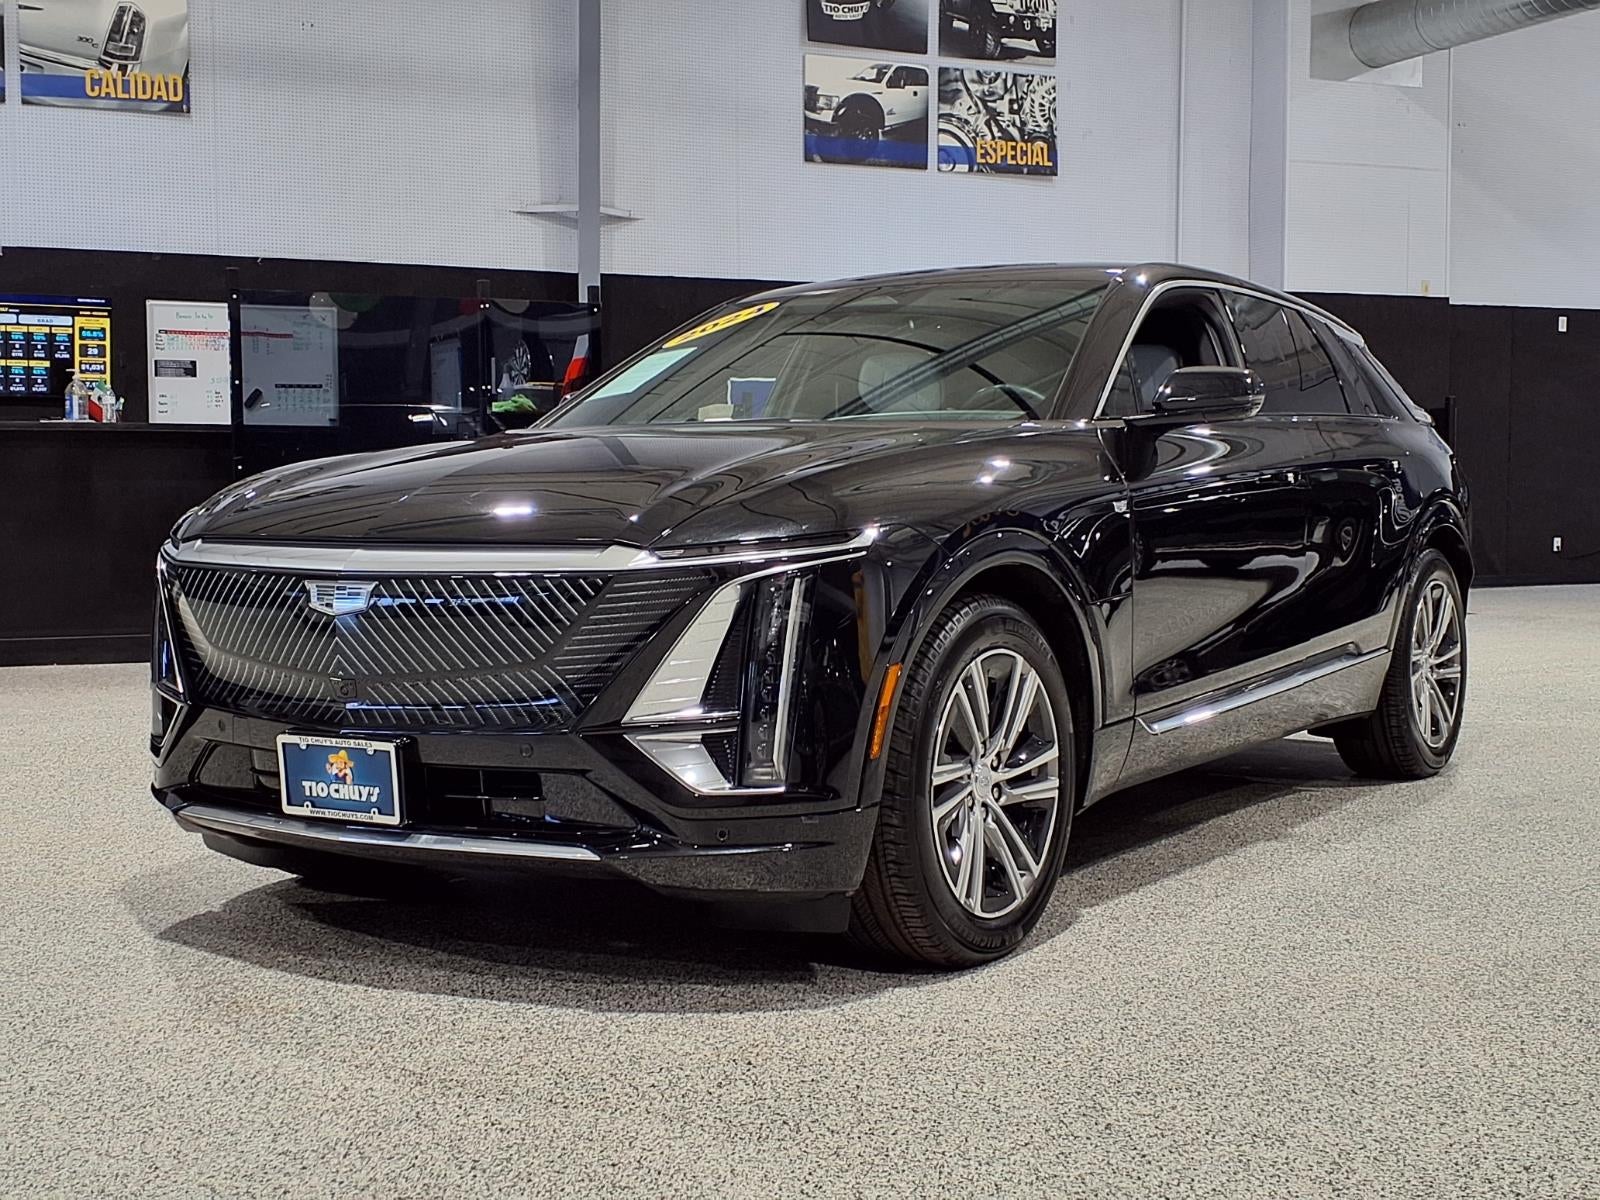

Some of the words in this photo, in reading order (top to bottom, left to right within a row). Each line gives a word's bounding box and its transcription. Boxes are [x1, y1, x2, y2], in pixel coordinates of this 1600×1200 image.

[823, 4, 840, 13] TIO
[84, 68, 184, 102] CALIDAD
[976, 138, 1053, 167] ESPECIAL
[310, 737, 334, 746] CHUY'S
[334, 739, 352, 747] AUTO
[309, 809, 374, 821] WWW.TIOCHUYS.COM
